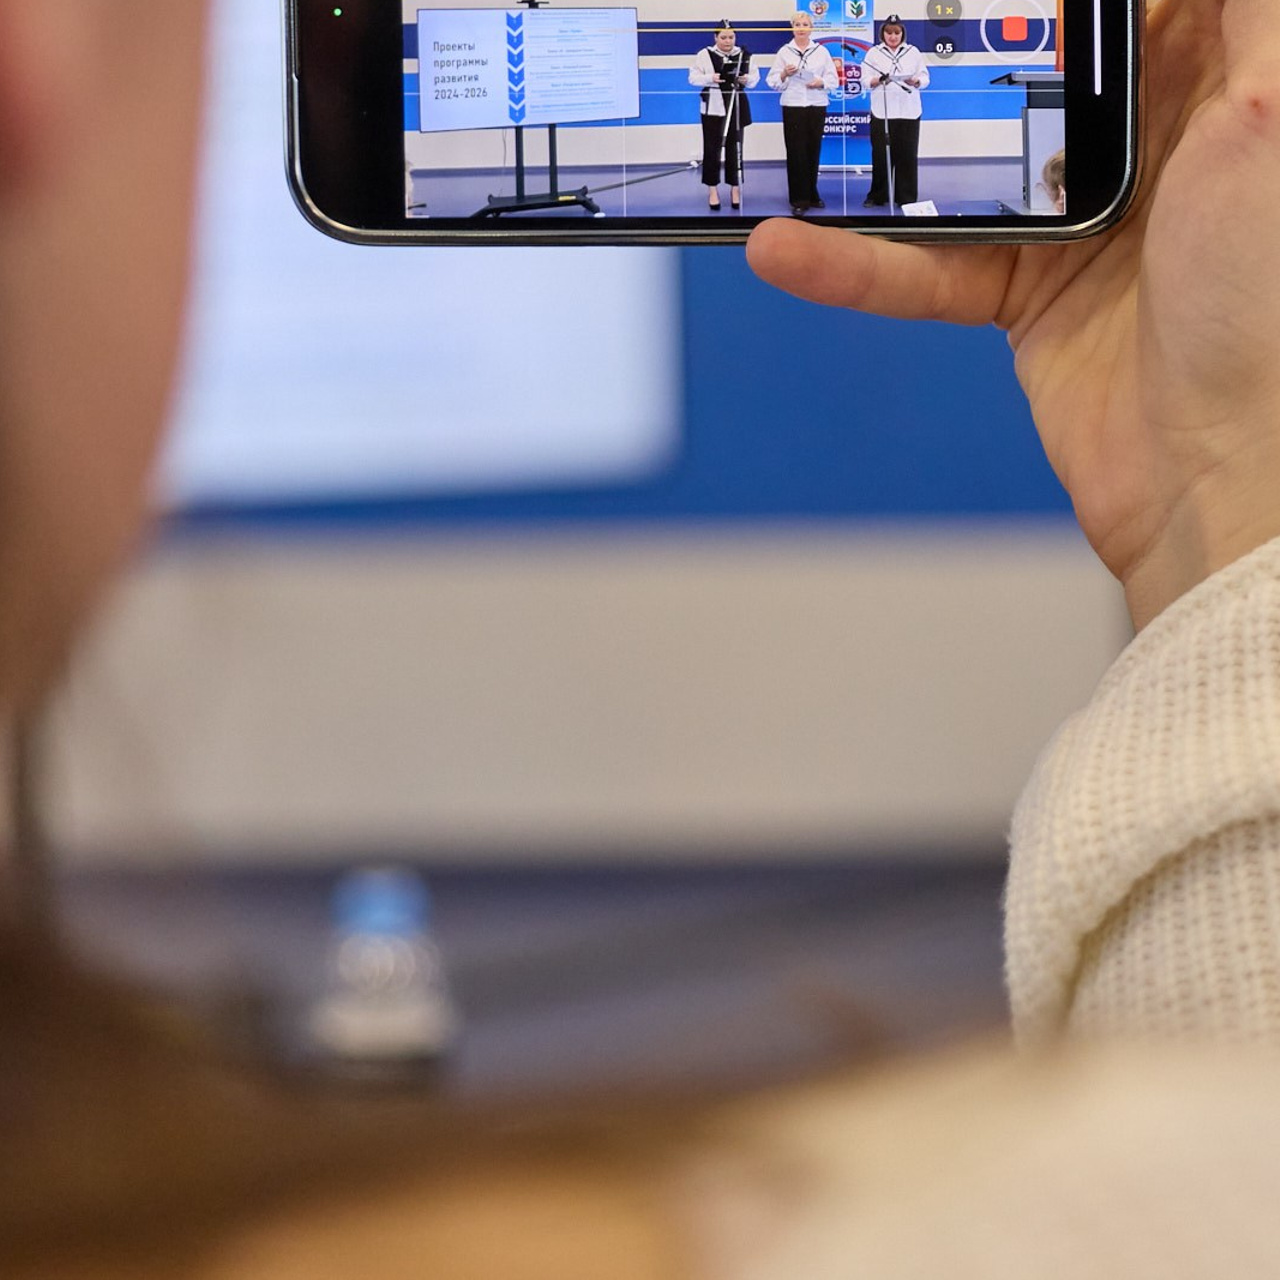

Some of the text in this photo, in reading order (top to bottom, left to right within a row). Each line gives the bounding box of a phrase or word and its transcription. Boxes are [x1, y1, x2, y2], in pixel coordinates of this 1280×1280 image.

[433, 40, 476, 52] Проекты
[936, 43, 953, 54] 0,5
[433, 57, 488, 69] программы
[433, 73, 479, 86] развития
[434, 87, 488, 100] 2024-2026
